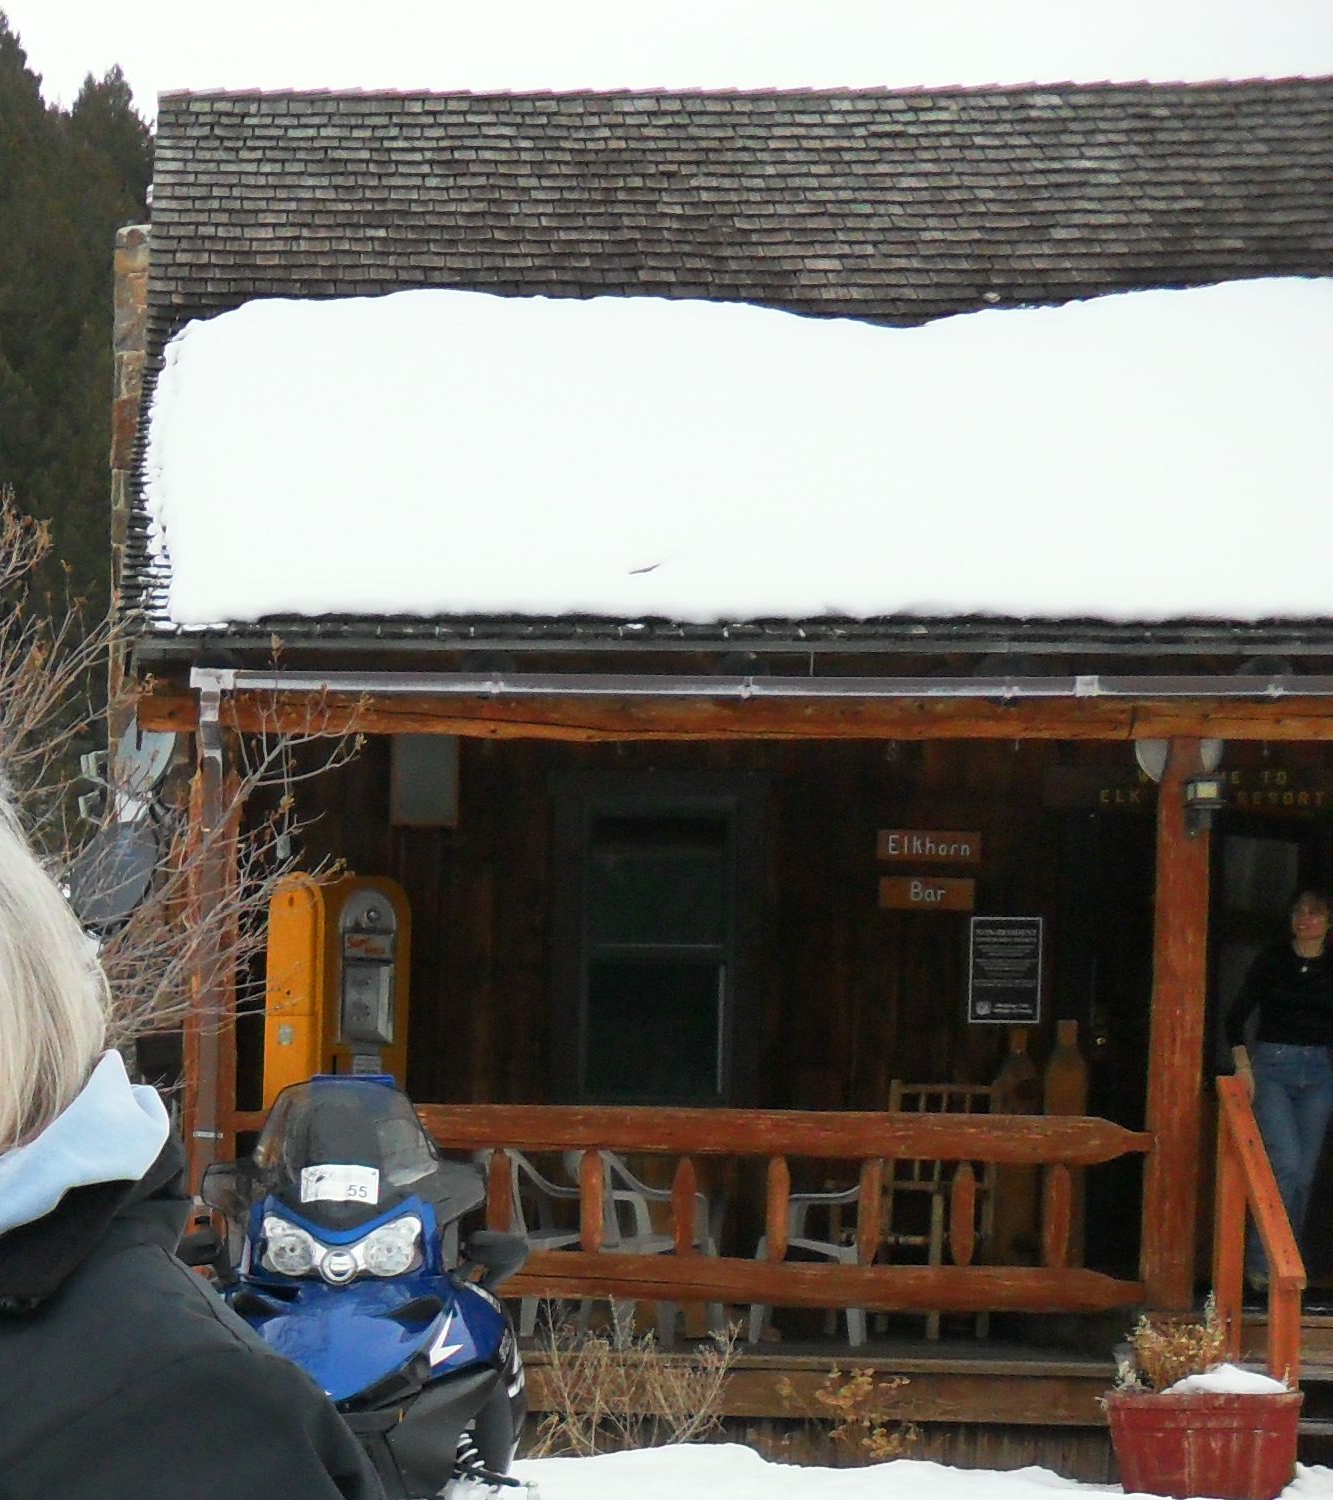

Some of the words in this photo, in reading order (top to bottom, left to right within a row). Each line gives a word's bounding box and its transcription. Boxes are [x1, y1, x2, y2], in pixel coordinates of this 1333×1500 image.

[888, 834, 970, 857] Elkhorn
[910, 880, 946, 901] Bar
[348, 1184, 368, 1198] 55
